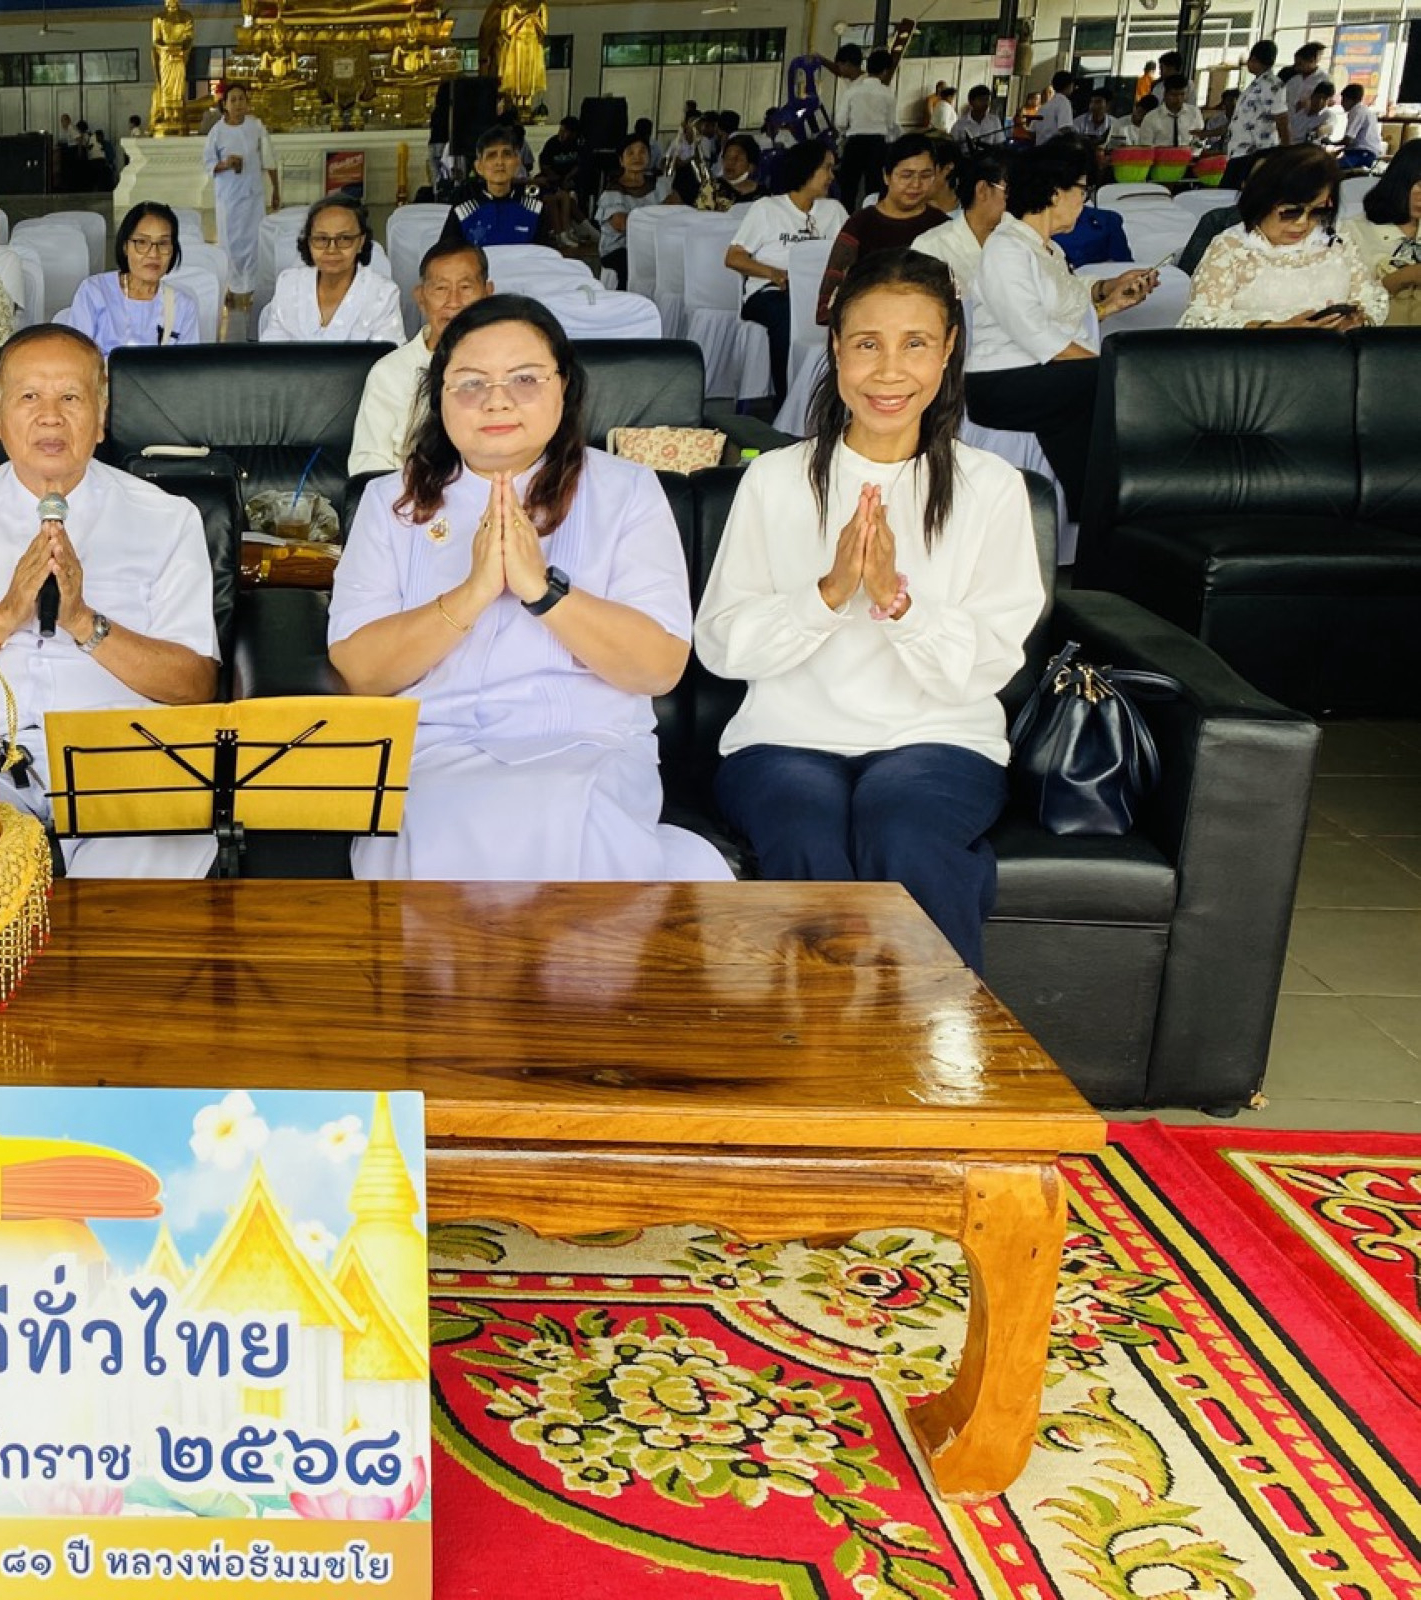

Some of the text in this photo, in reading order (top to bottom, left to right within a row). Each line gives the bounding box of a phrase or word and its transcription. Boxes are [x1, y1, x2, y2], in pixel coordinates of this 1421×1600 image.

[156, 1425, 402, 1486] ๒๕๖๘
[3, 1553, 52, 1575] ๘๑
[68, 1540, 90, 1574] ปี
[107, 1544, 389, 1580] หลวงพ่อธัมมชโย
